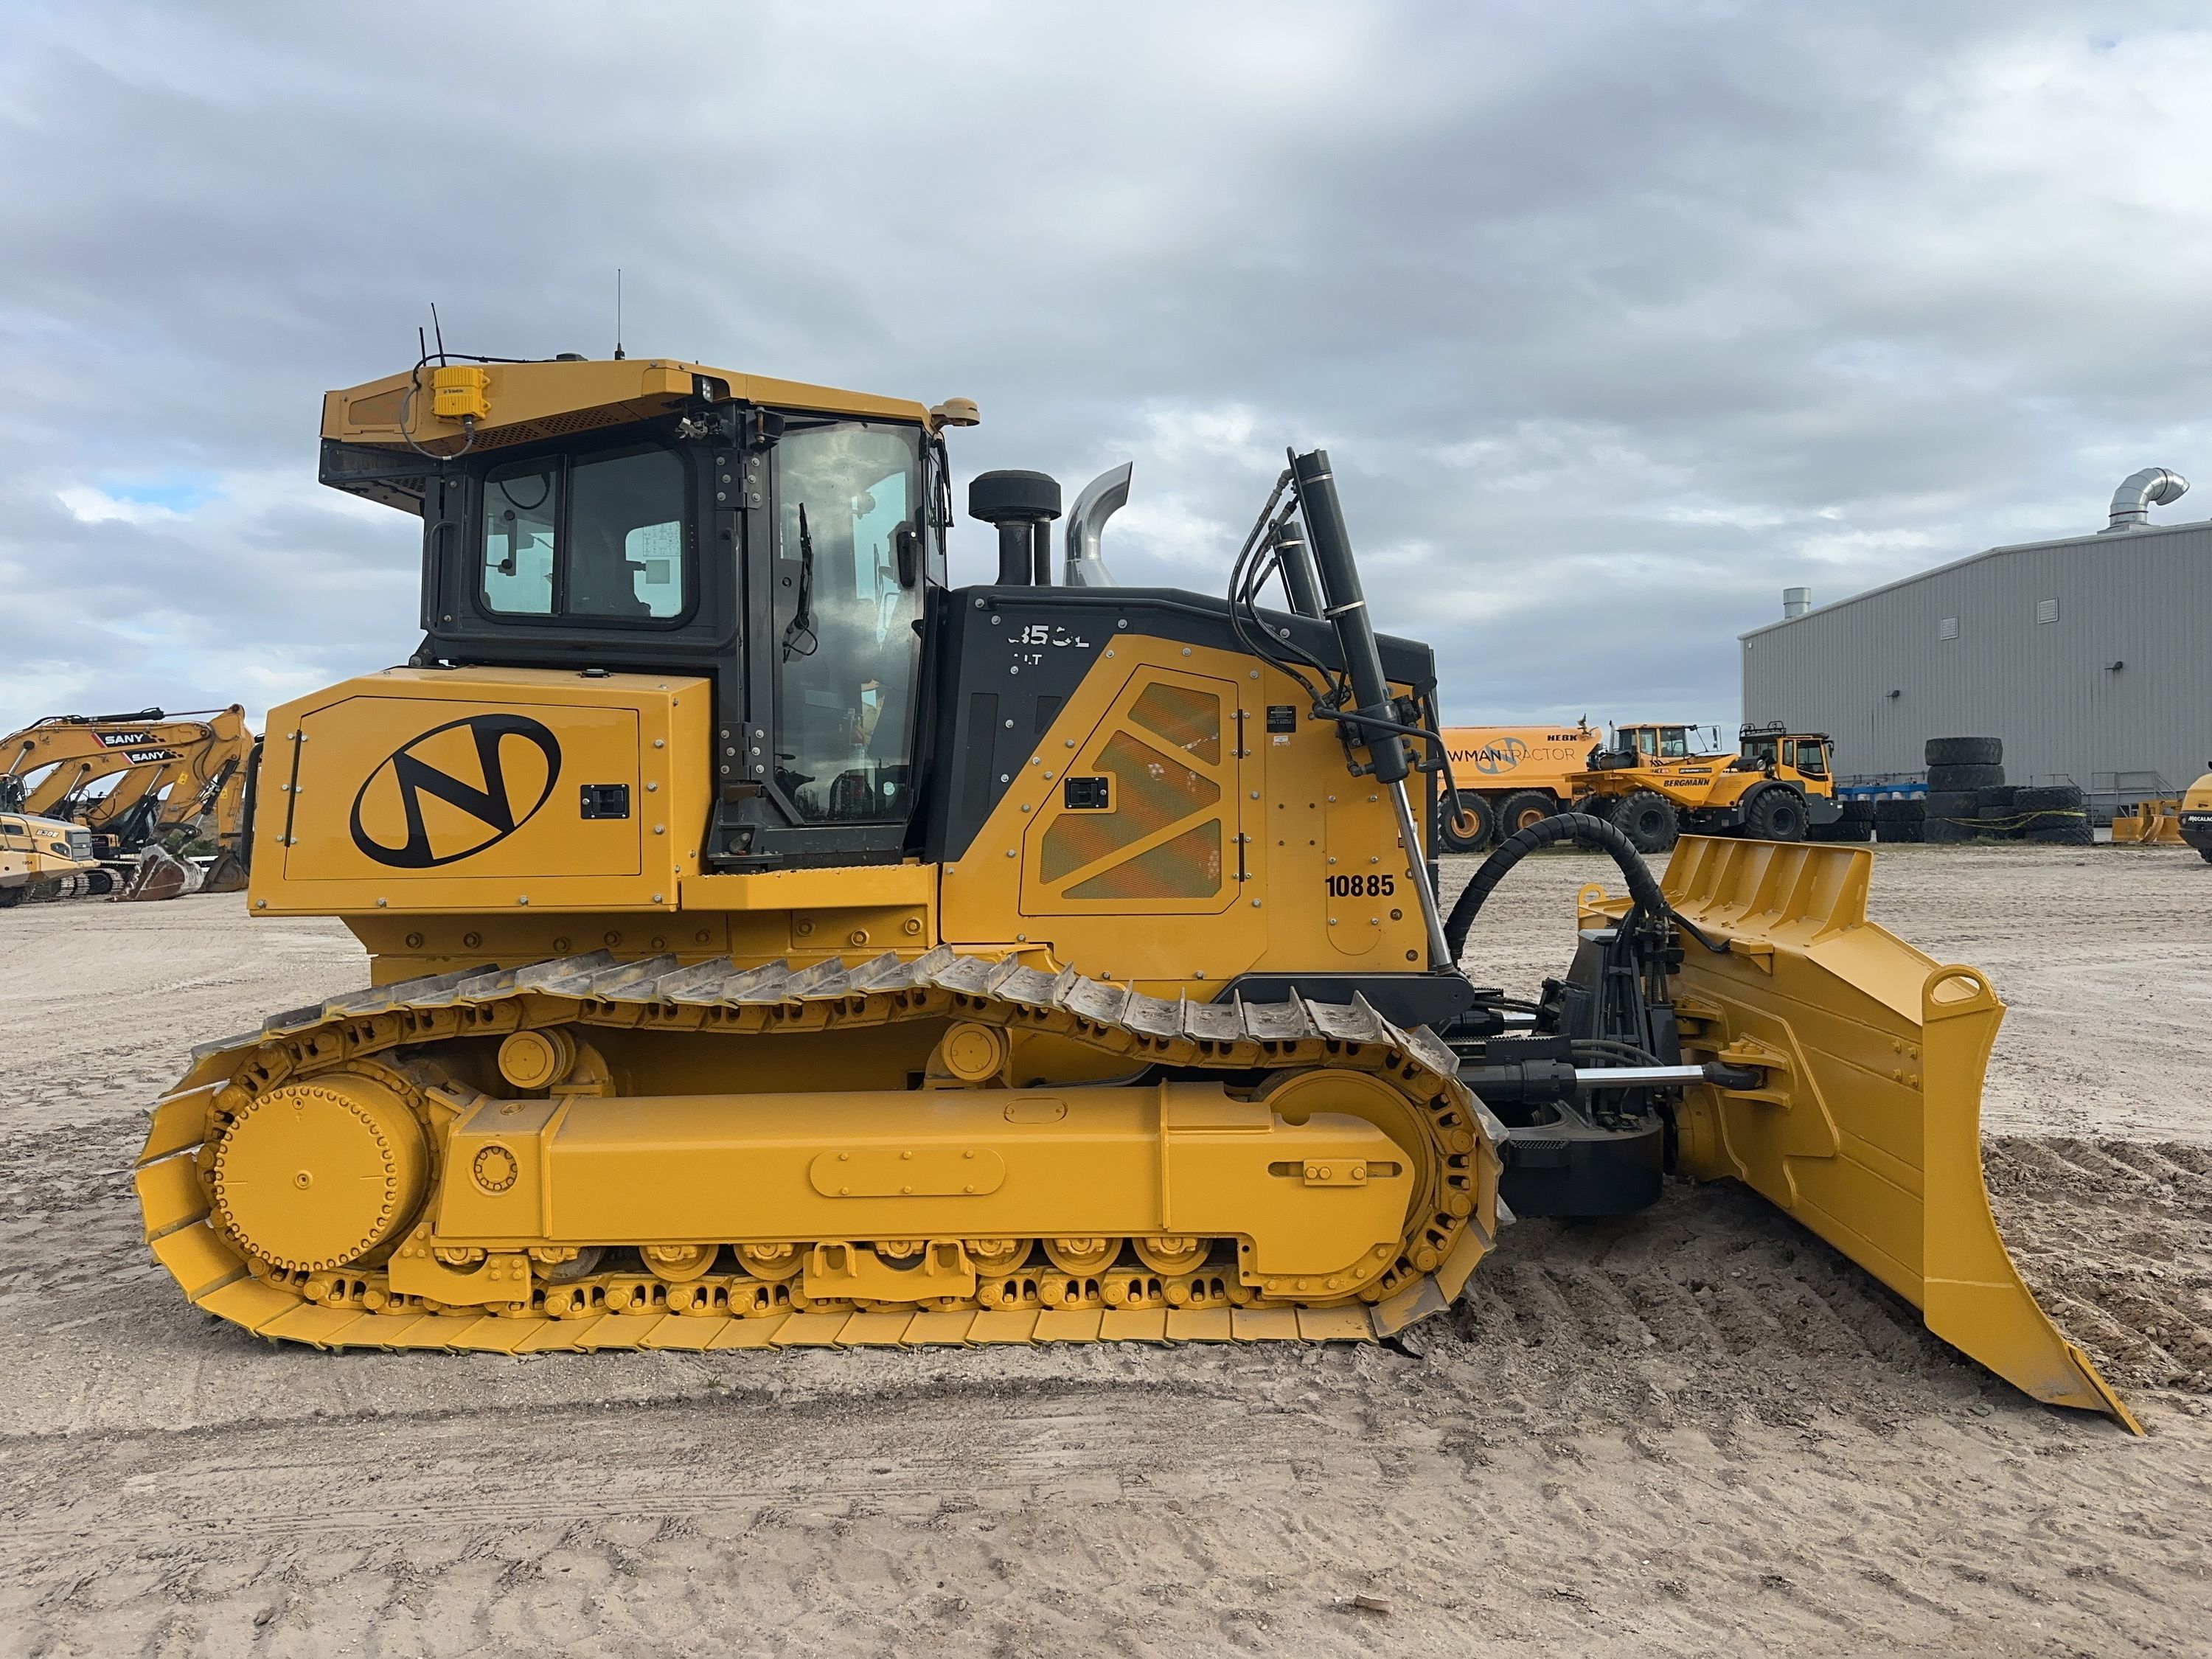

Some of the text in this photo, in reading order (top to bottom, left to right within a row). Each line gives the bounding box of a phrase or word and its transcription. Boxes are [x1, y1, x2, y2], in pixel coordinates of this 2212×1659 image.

[105, 734, 144, 745] SANY
[131, 751, 165, 762] SANY
[1447, 748, 1576, 762] WMANTRACTOR
[1663, 779, 1710, 787] BERGMANN
[1325, 874, 1394, 897] 10885
